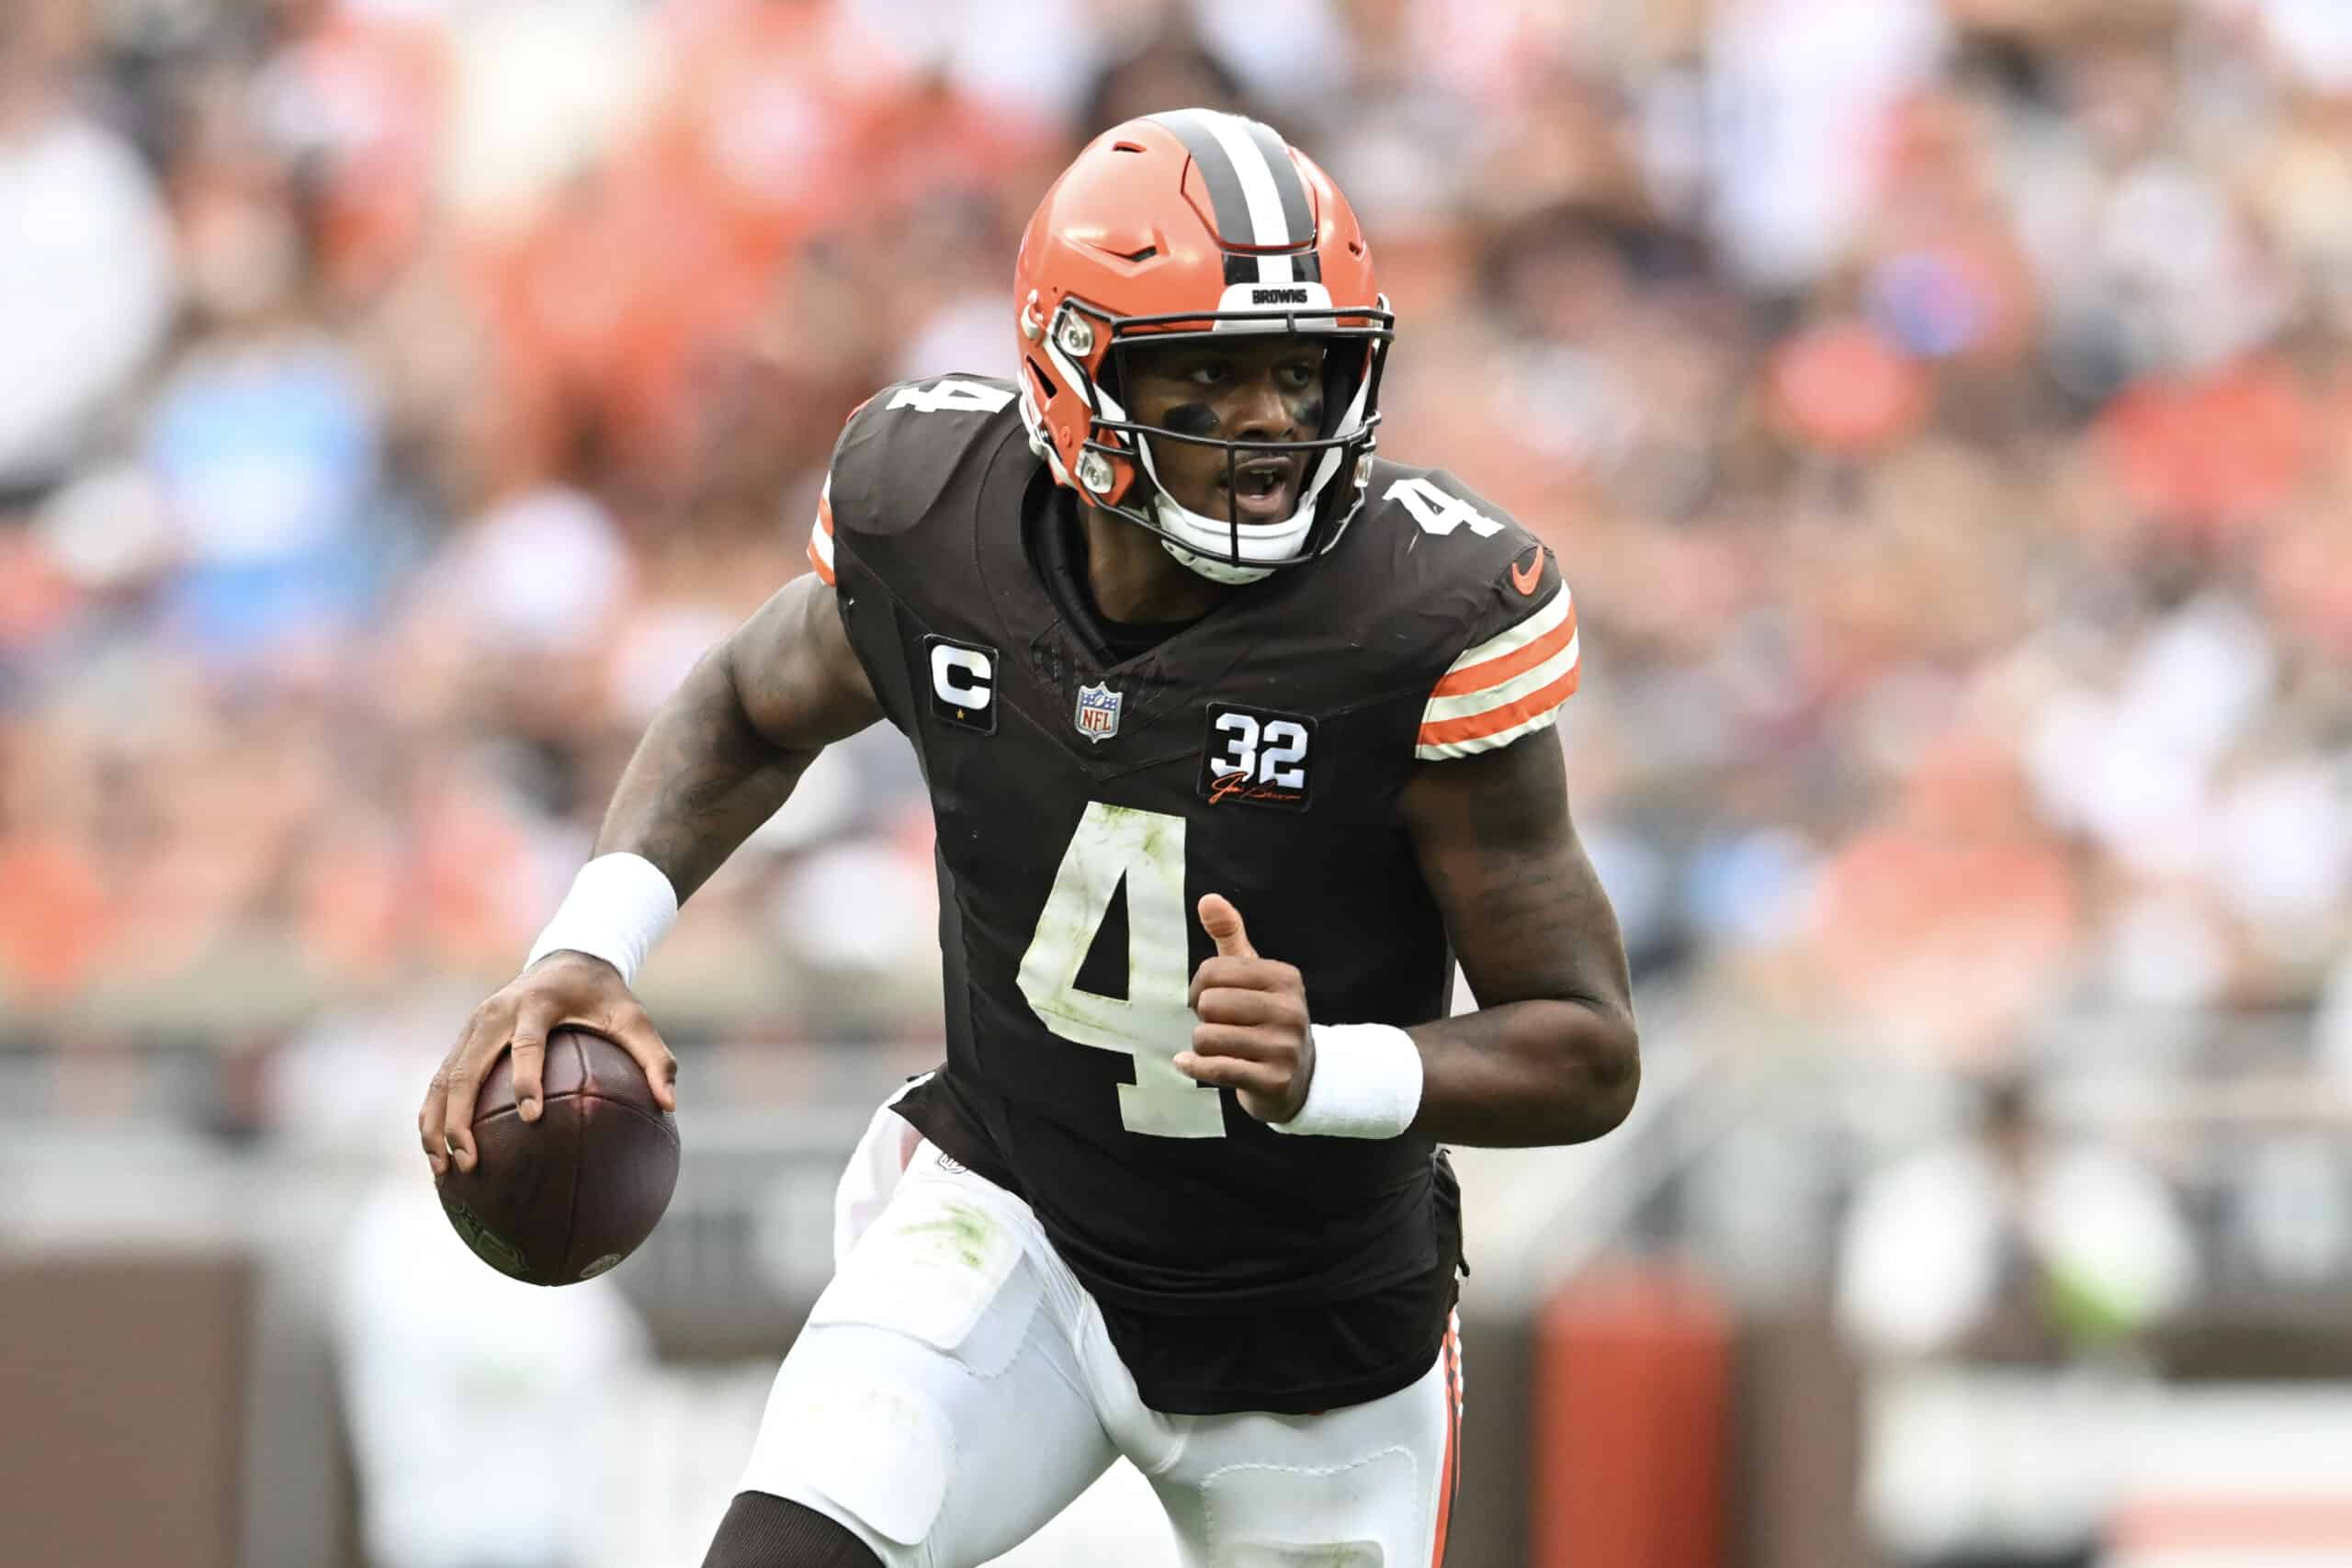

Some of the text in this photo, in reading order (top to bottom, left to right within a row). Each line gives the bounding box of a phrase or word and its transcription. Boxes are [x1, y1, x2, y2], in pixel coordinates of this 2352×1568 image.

[1252, 288, 1307, 304] BROWNS
[885, 379, 1016, 413] 4
[1382, 478, 1506, 538] 4
[931, 644, 991, 710] C
[1082, 709, 1111, 732] NFL
[1211, 713, 1308, 788] 32
[1015, 801, 1227, 1138] 4
